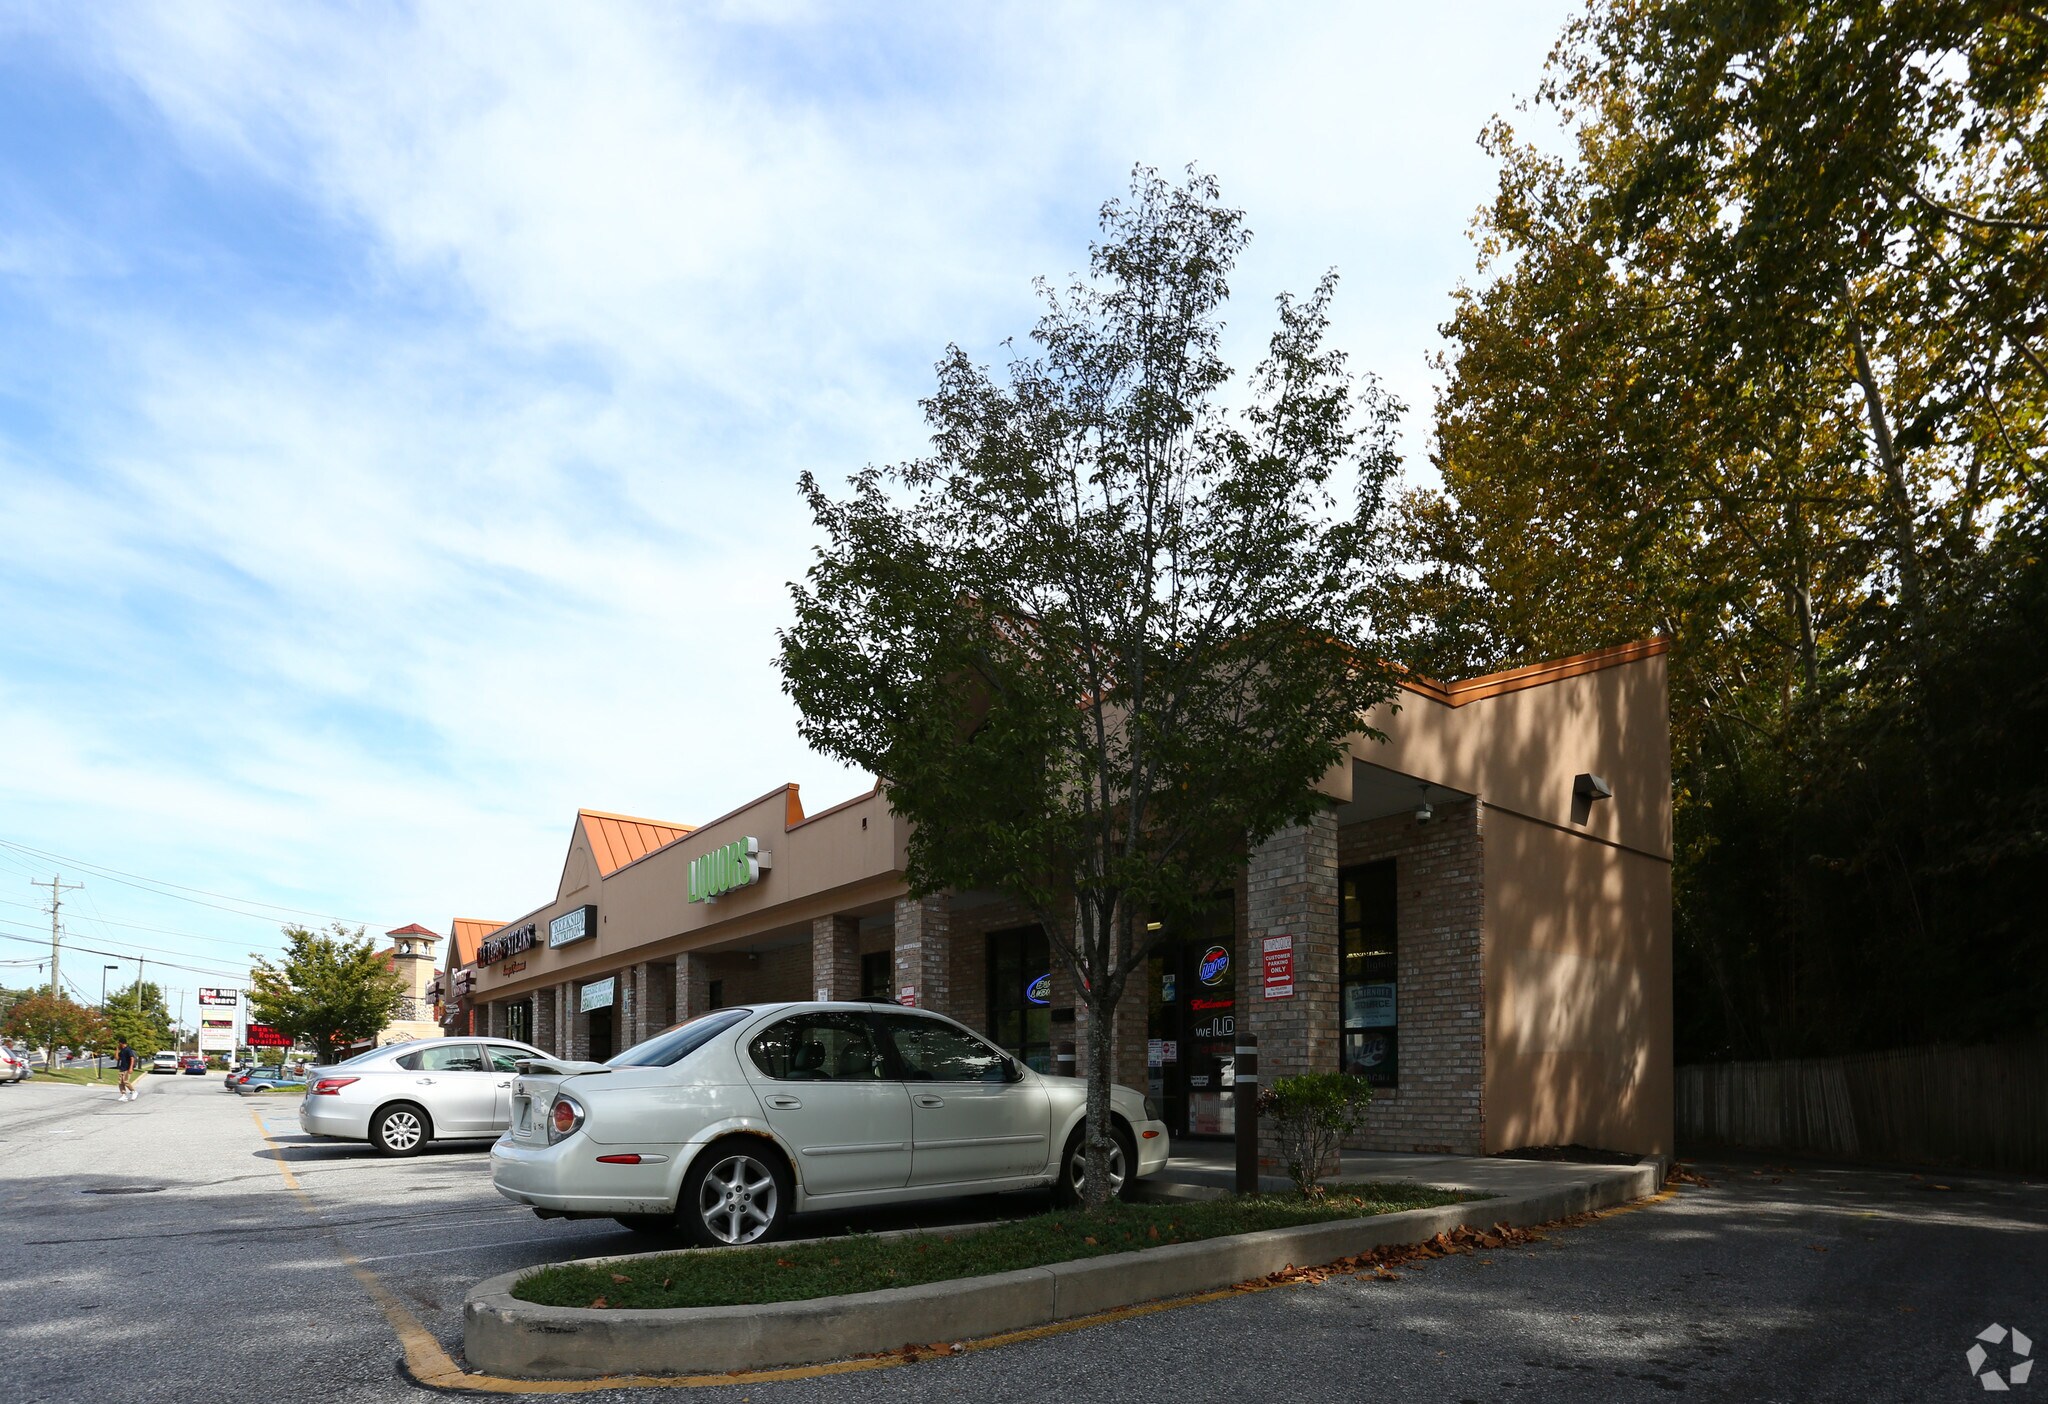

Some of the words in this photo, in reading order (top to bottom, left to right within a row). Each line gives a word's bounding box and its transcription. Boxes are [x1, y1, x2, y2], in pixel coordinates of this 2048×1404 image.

[687, 836, 758, 904] LIQUORS
[551, 909, 585, 934] CREEKSIDE
[551, 925, 581, 944] NUTRITION
[1265, 953, 1290, 961] CUSTOMER
[1267, 959, 1288, 967] PARKING
[1270, 966, 1286, 974] ONLY
[200, 989, 216, 997] Red
[219, 989, 235, 997] Mill
[1353, 987, 1392, 999] SMIRNOFF
[203, 996, 235, 1005] Square
[1354, 1000, 1392, 1010] SOURCE
[1195, 1028, 1211, 1038] WE
[248, 1037, 291, 1045] Available
